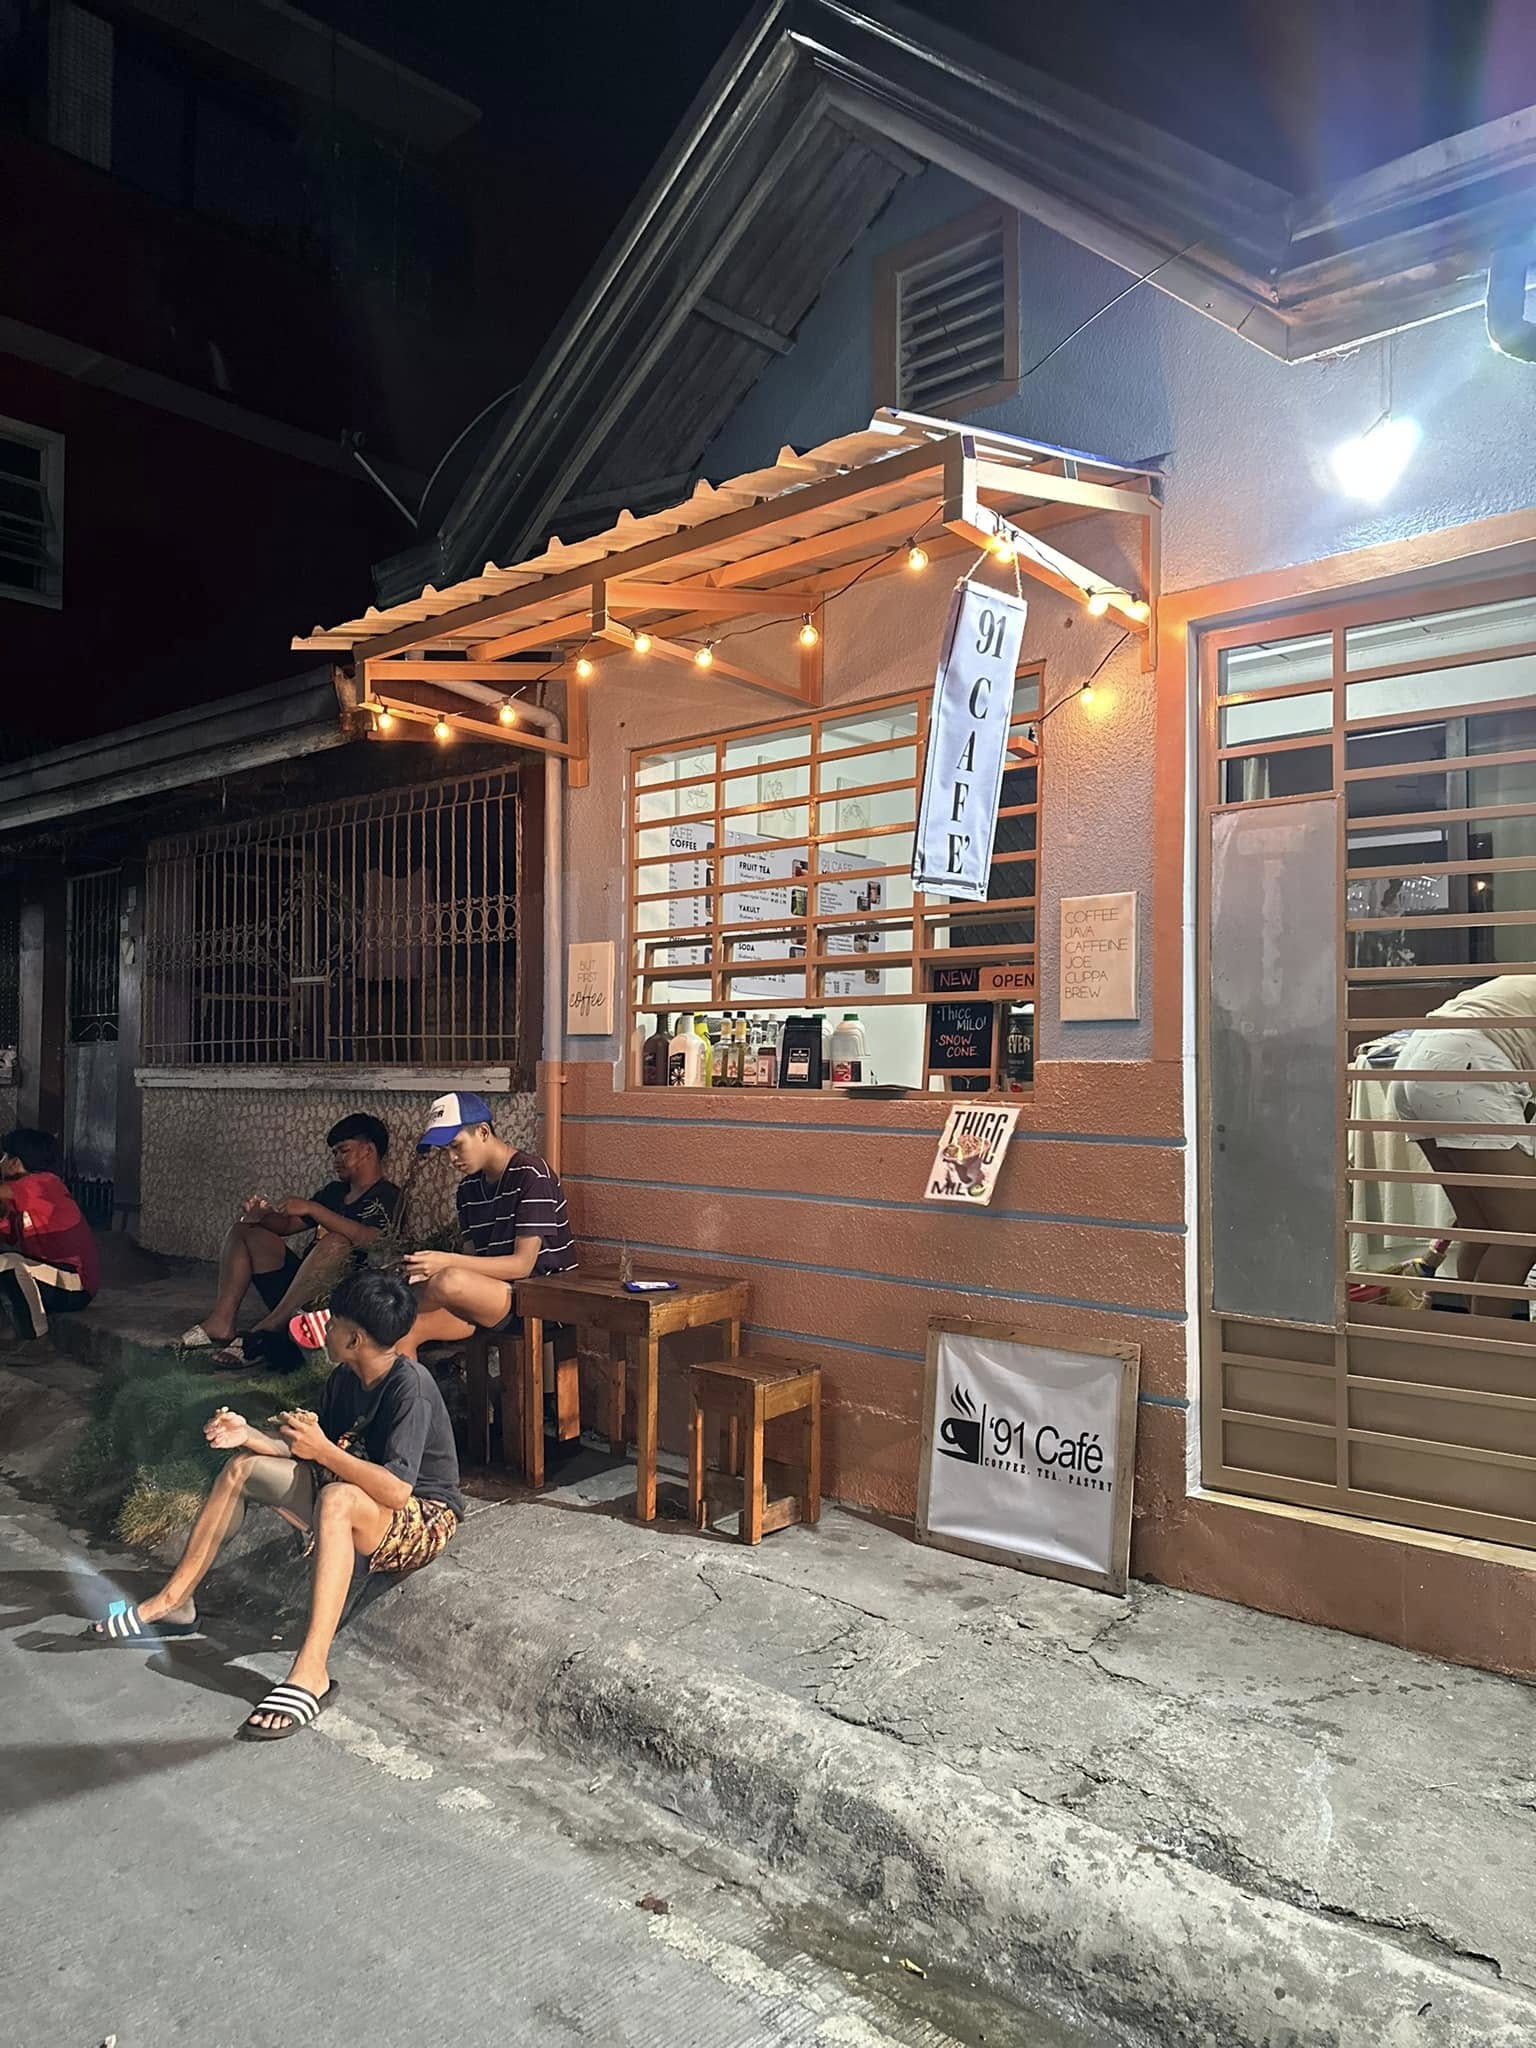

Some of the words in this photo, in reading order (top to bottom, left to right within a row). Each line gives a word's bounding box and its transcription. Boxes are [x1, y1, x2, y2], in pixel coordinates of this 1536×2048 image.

[975, 609, 1008, 660] 91
[670, 838, 697, 851] COFFEE
[739, 861, 758, 873] FRUIT
[759, 864, 771, 875] TEA
[738, 903, 761, 915] YAKULT
[1064, 907, 1120, 924] COFFEE
[1064, 925, 1096, 940] JAVA
[738, 943, 755, 952] SODA
[1064, 937, 1128, 954] CAFFEINE
[1064, 955, 1092, 969] JOE
[992, 973, 1034, 988] OPEN
[1064, 969, 1108, 985] CUPPA
[569, 983, 606, 1017] coffee
[1064, 985, 1101, 1000] BREW
[939, 1032, 972, 1046] SNOW
[946, 1045, 977, 1058] CONE
[1035, 1425, 1104, 1474] Café
[984, 1457, 1031, 1475] COFFEE.
[1068, 1474, 1113, 1493] PASTRY
